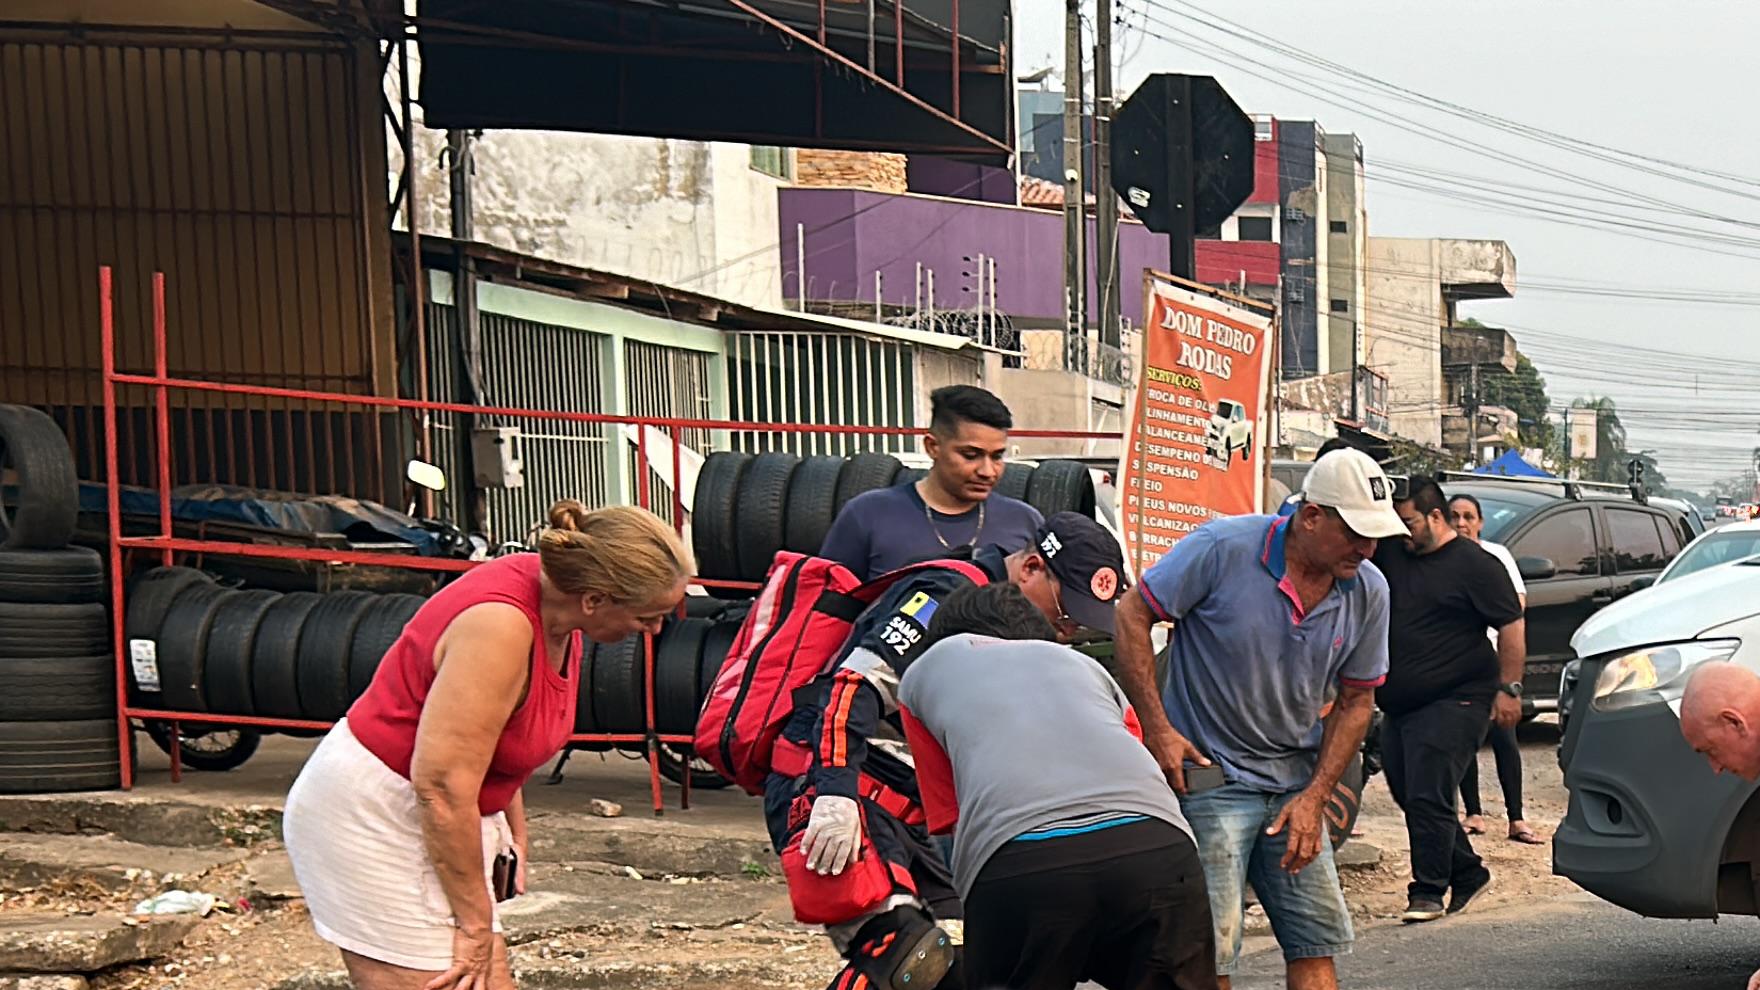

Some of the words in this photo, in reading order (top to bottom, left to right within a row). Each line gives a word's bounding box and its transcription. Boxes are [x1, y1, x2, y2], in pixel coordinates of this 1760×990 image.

[1161, 306, 1203, 339] DOM
[1206, 319, 1256, 356] PEDRO
[1176, 341, 1233, 381] RODAS
[1144, 388, 1175, 404] ROCA
[1177, 395, 1193, 408] DE
[1145, 407, 1212, 431] LINHAMENTO
[1134, 440, 1201, 464] DSEMPENO
[1132, 459, 1199, 480] SSPENSÃO
[1128, 495, 1166, 511] PEUS
[1167, 501, 1207, 517] NOVOS
[880, 626, 911, 656] 192
[889, 616, 922, 644] SAMU
